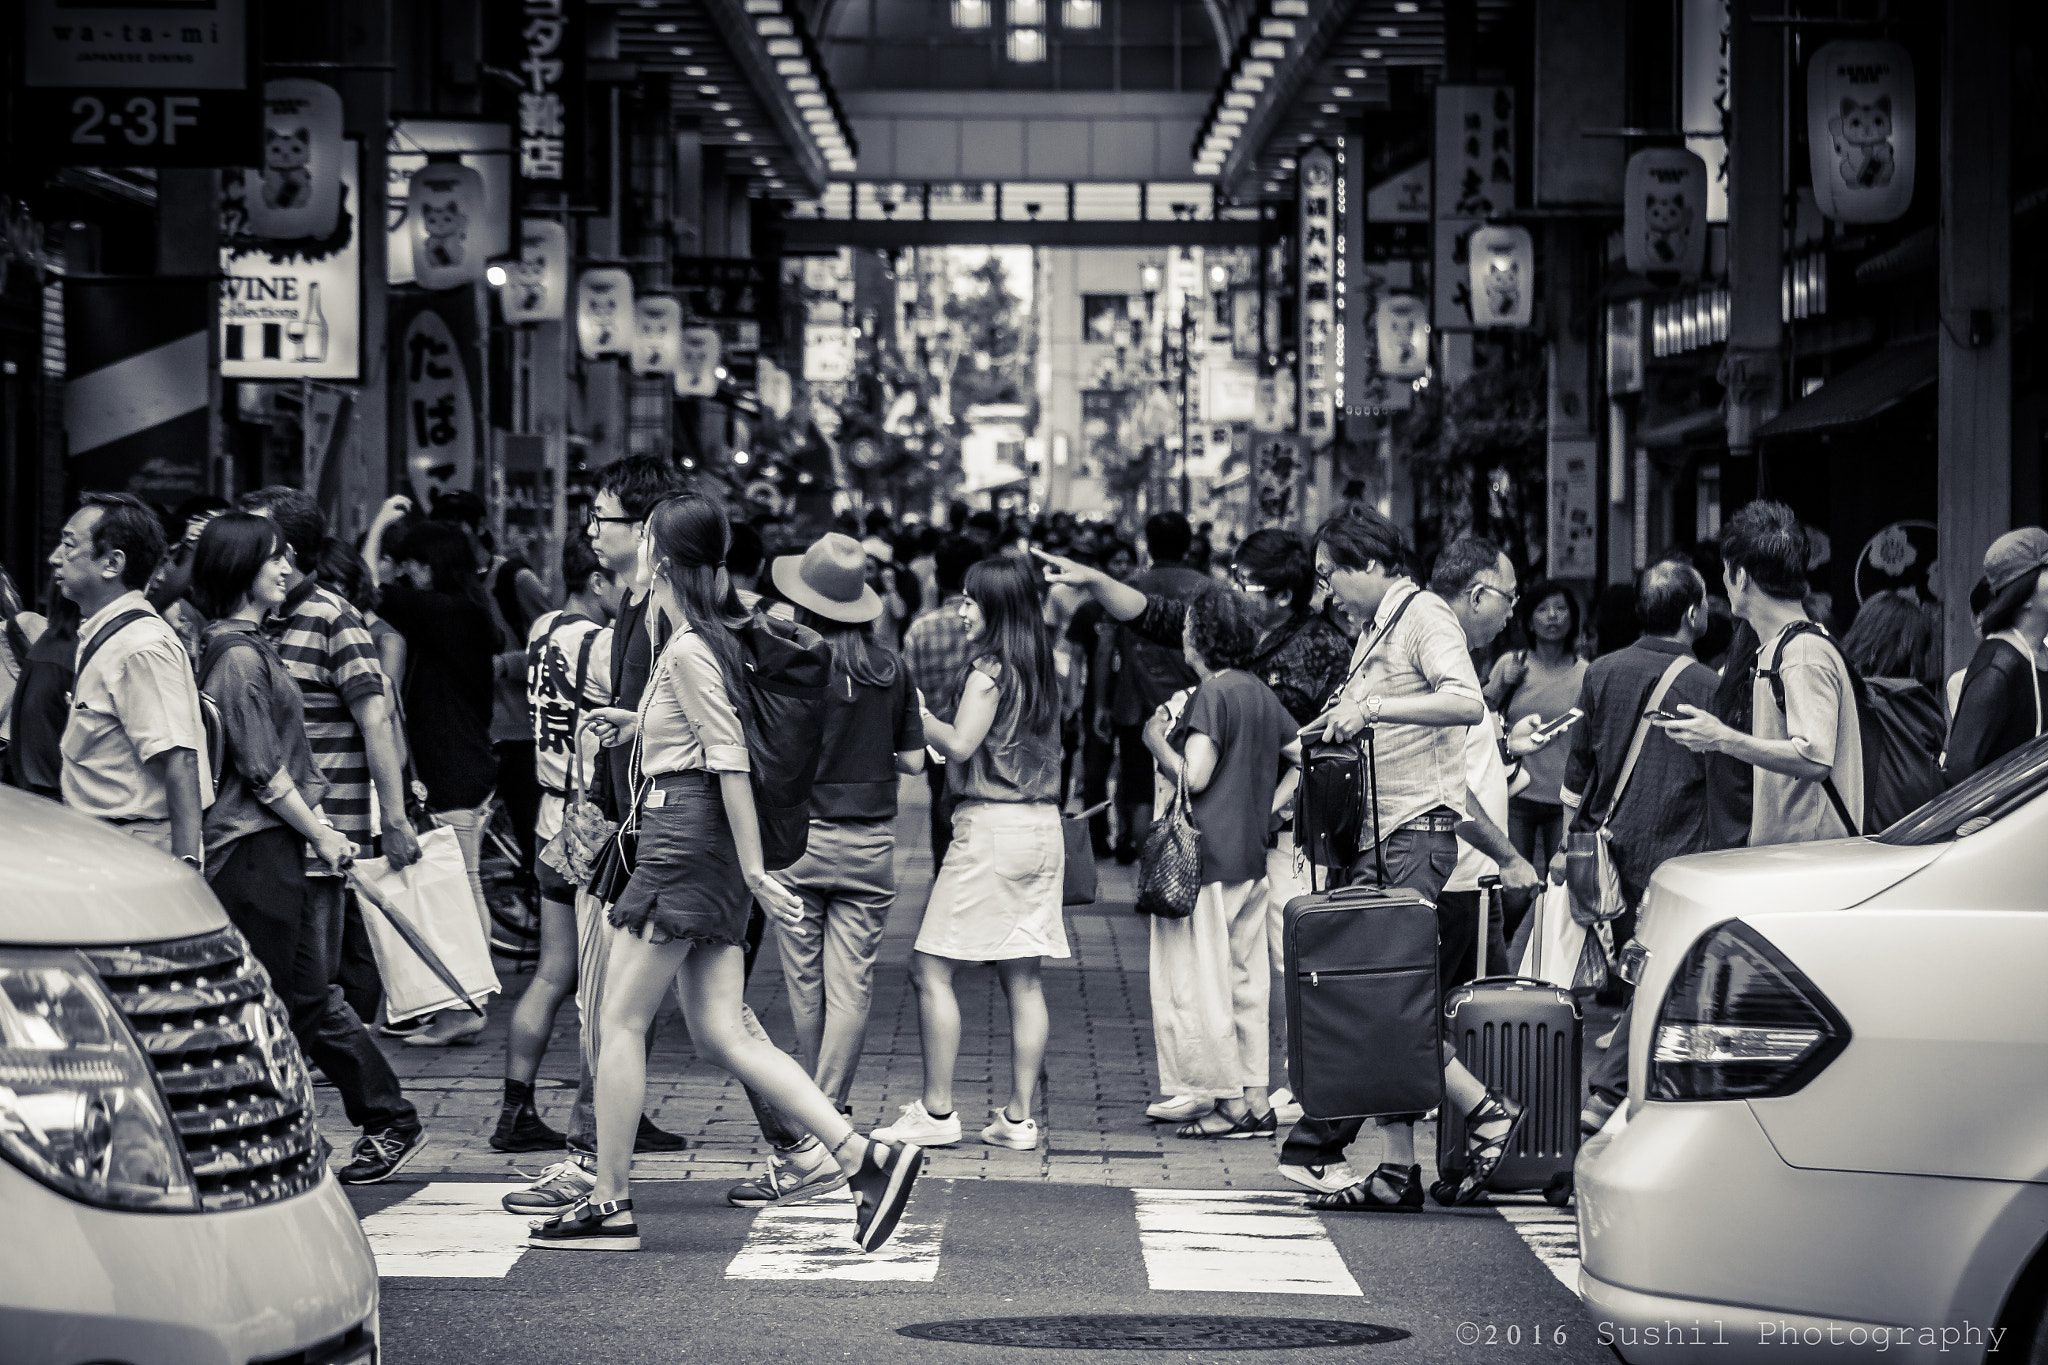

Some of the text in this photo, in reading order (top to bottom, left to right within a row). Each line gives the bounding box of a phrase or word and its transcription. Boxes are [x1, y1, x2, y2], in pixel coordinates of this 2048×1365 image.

[54, 22, 218, 43] wa-ta-mi
[76, 53, 194, 63] JAPANESE DINING
